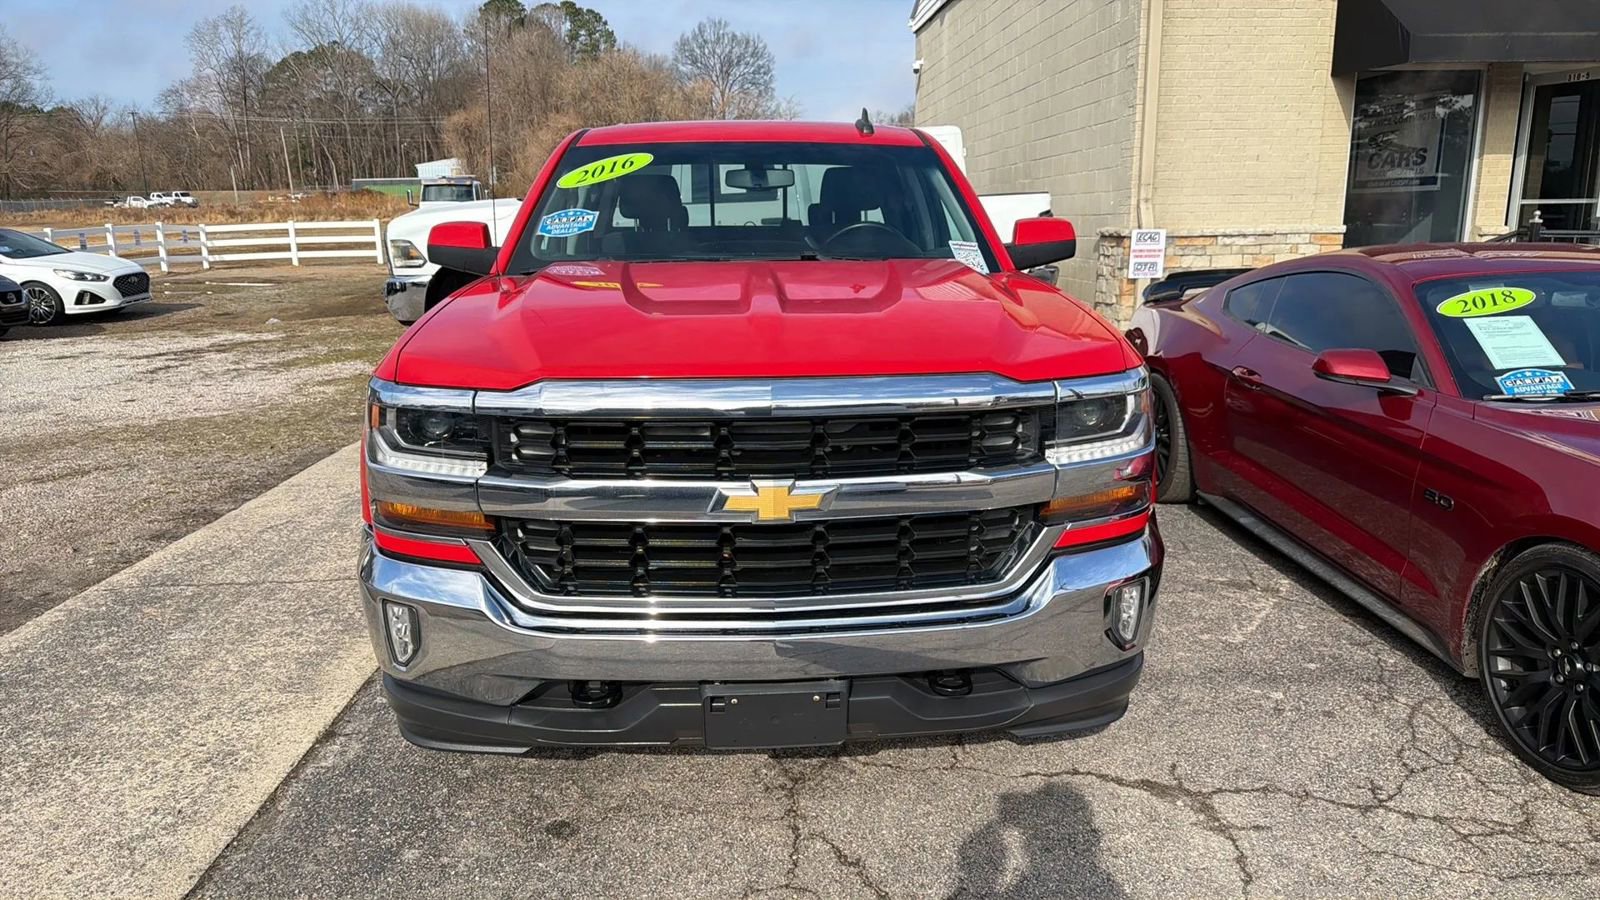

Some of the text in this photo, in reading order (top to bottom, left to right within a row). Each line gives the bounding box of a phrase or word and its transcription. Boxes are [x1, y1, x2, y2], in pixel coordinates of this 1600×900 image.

[1367, 147, 1428, 170] CARS
[575, 156, 635, 185] 2016
[546, 222, 588, 231] ADVANTAGE
[1456, 289, 1516, 314] 2018
[1513, 384, 1563, 393] ADVANTAGE
